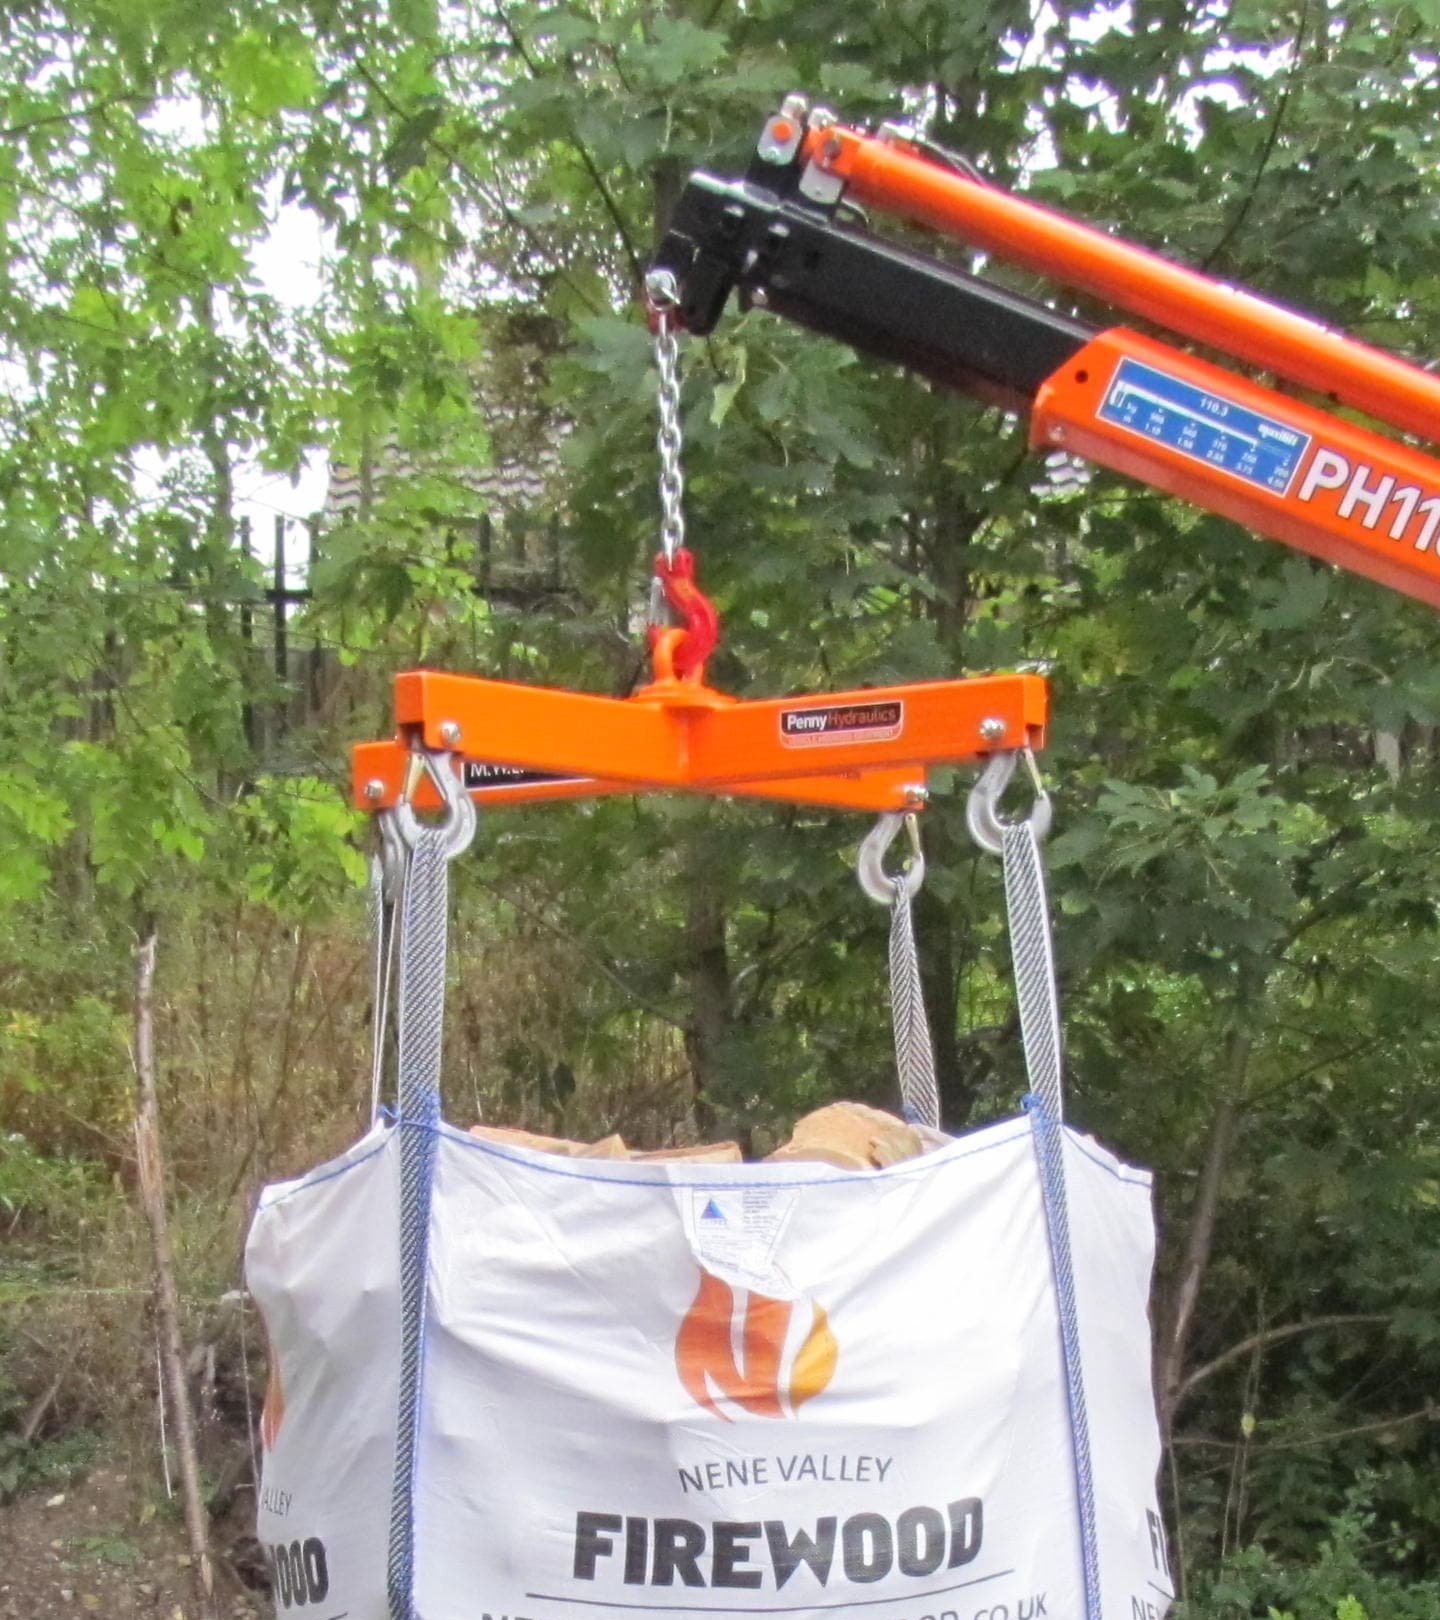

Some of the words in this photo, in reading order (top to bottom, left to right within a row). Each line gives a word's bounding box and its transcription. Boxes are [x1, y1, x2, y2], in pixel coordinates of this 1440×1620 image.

[678, 1457, 768, 1493] NENE
[776, 1454, 893, 1482] VALLEY
[261, 1488, 293, 1518] ALLEY
[573, 1496, 983, 1592] FIREWOOD
[270, 1536, 328, 1609] OOD
